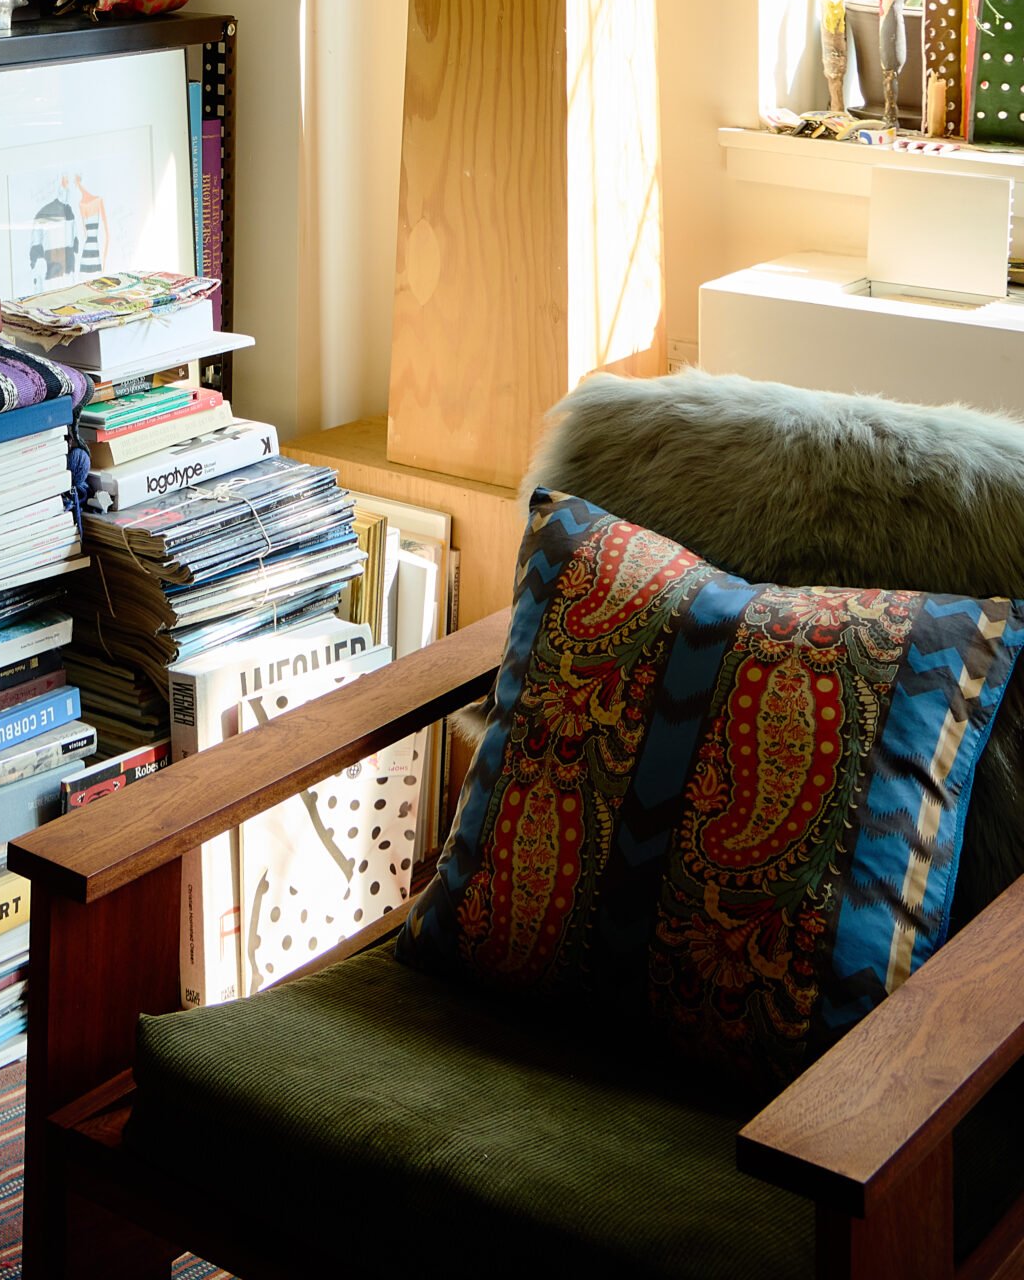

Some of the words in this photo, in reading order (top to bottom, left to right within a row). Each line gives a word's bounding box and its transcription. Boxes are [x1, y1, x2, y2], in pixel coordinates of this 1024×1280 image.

[212, 188, 220, 226] FAIRY
[212, 233, 221, 277] TALES
[146, 462, 203, 495] logotype
[41, 705, 55, 727] LE
[172, 680, 196, 727] WEGNER
[68, 739, 88, 750] vintage
[135, 758, 159, 779] Robes
[160, 756, 169, 769] of
